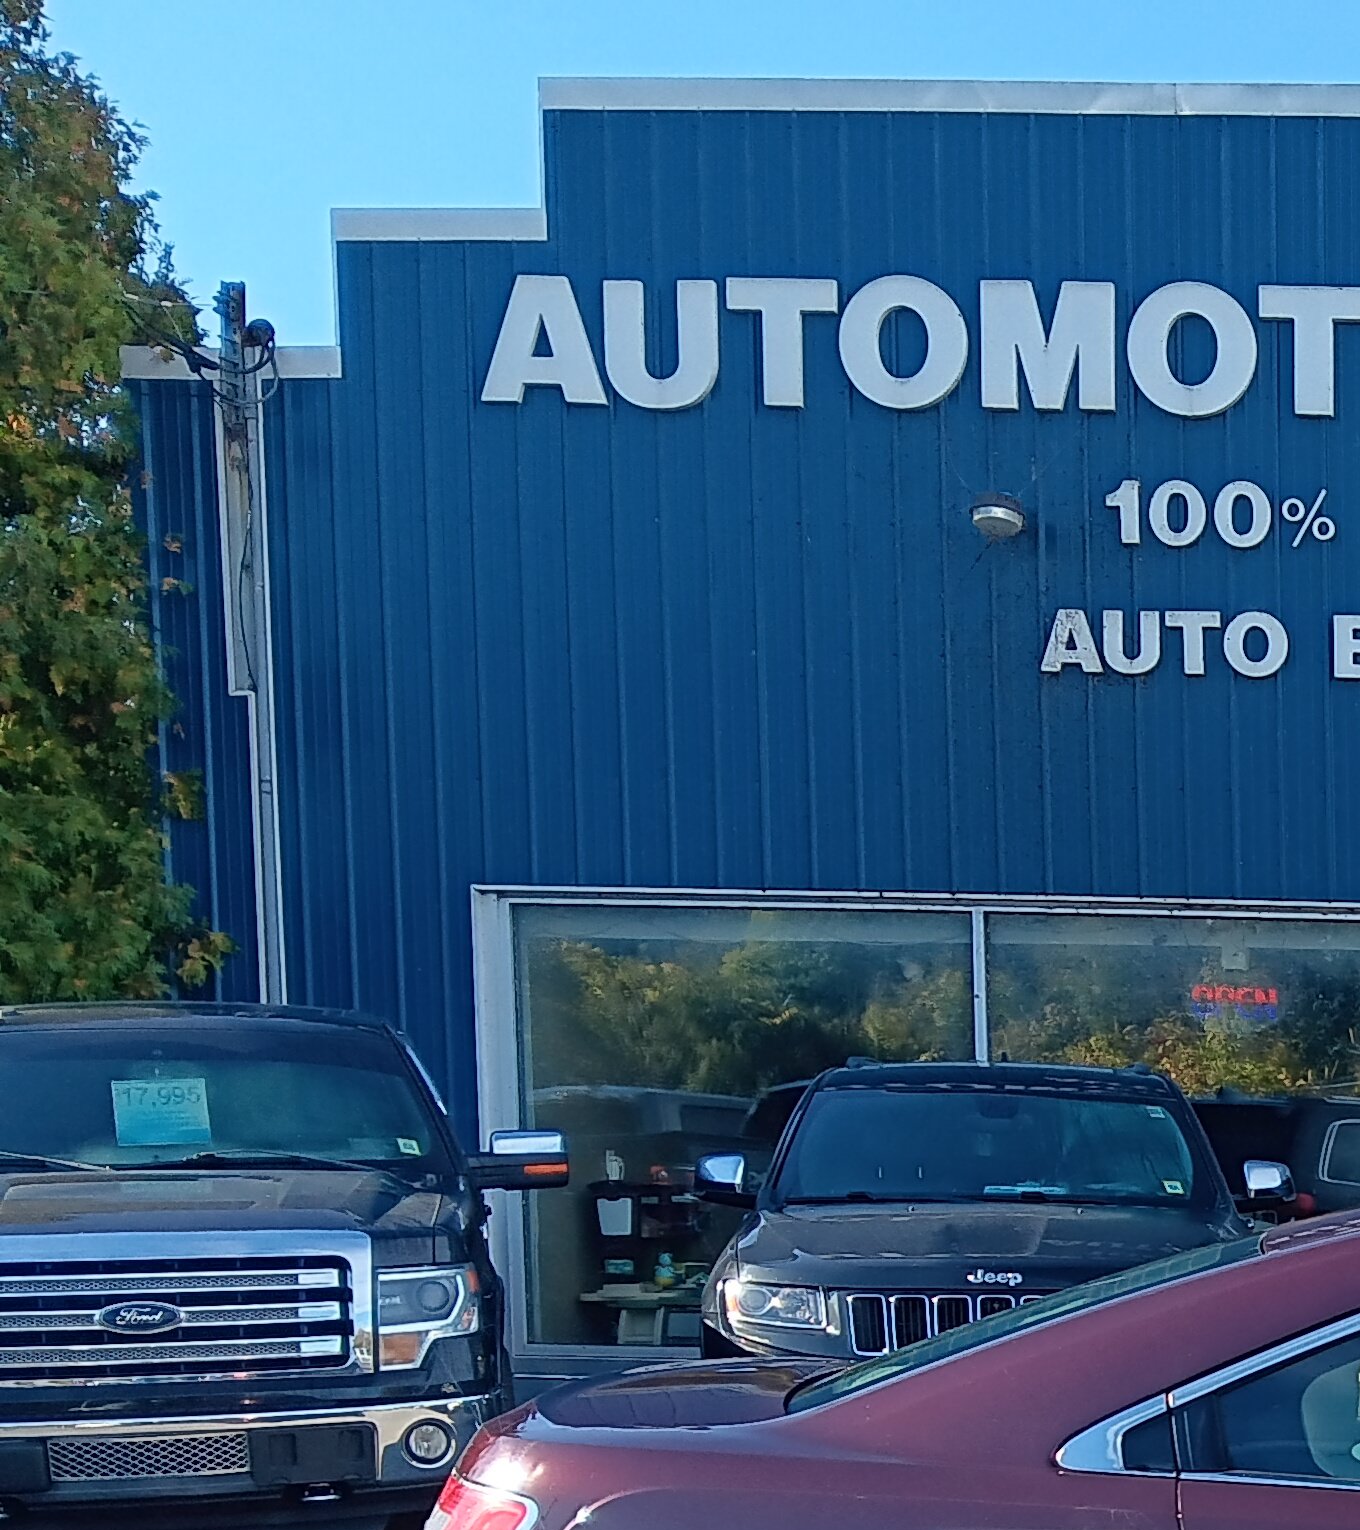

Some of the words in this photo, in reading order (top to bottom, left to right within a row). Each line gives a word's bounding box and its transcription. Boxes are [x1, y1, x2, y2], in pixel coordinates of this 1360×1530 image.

[1106, 480, 1336, 548] 100%
[1041, 609, 1288, 678] AUTO
[967, 1268, 1023, 1287] Jeep
[116, 1307, 164, 1325] Ford
